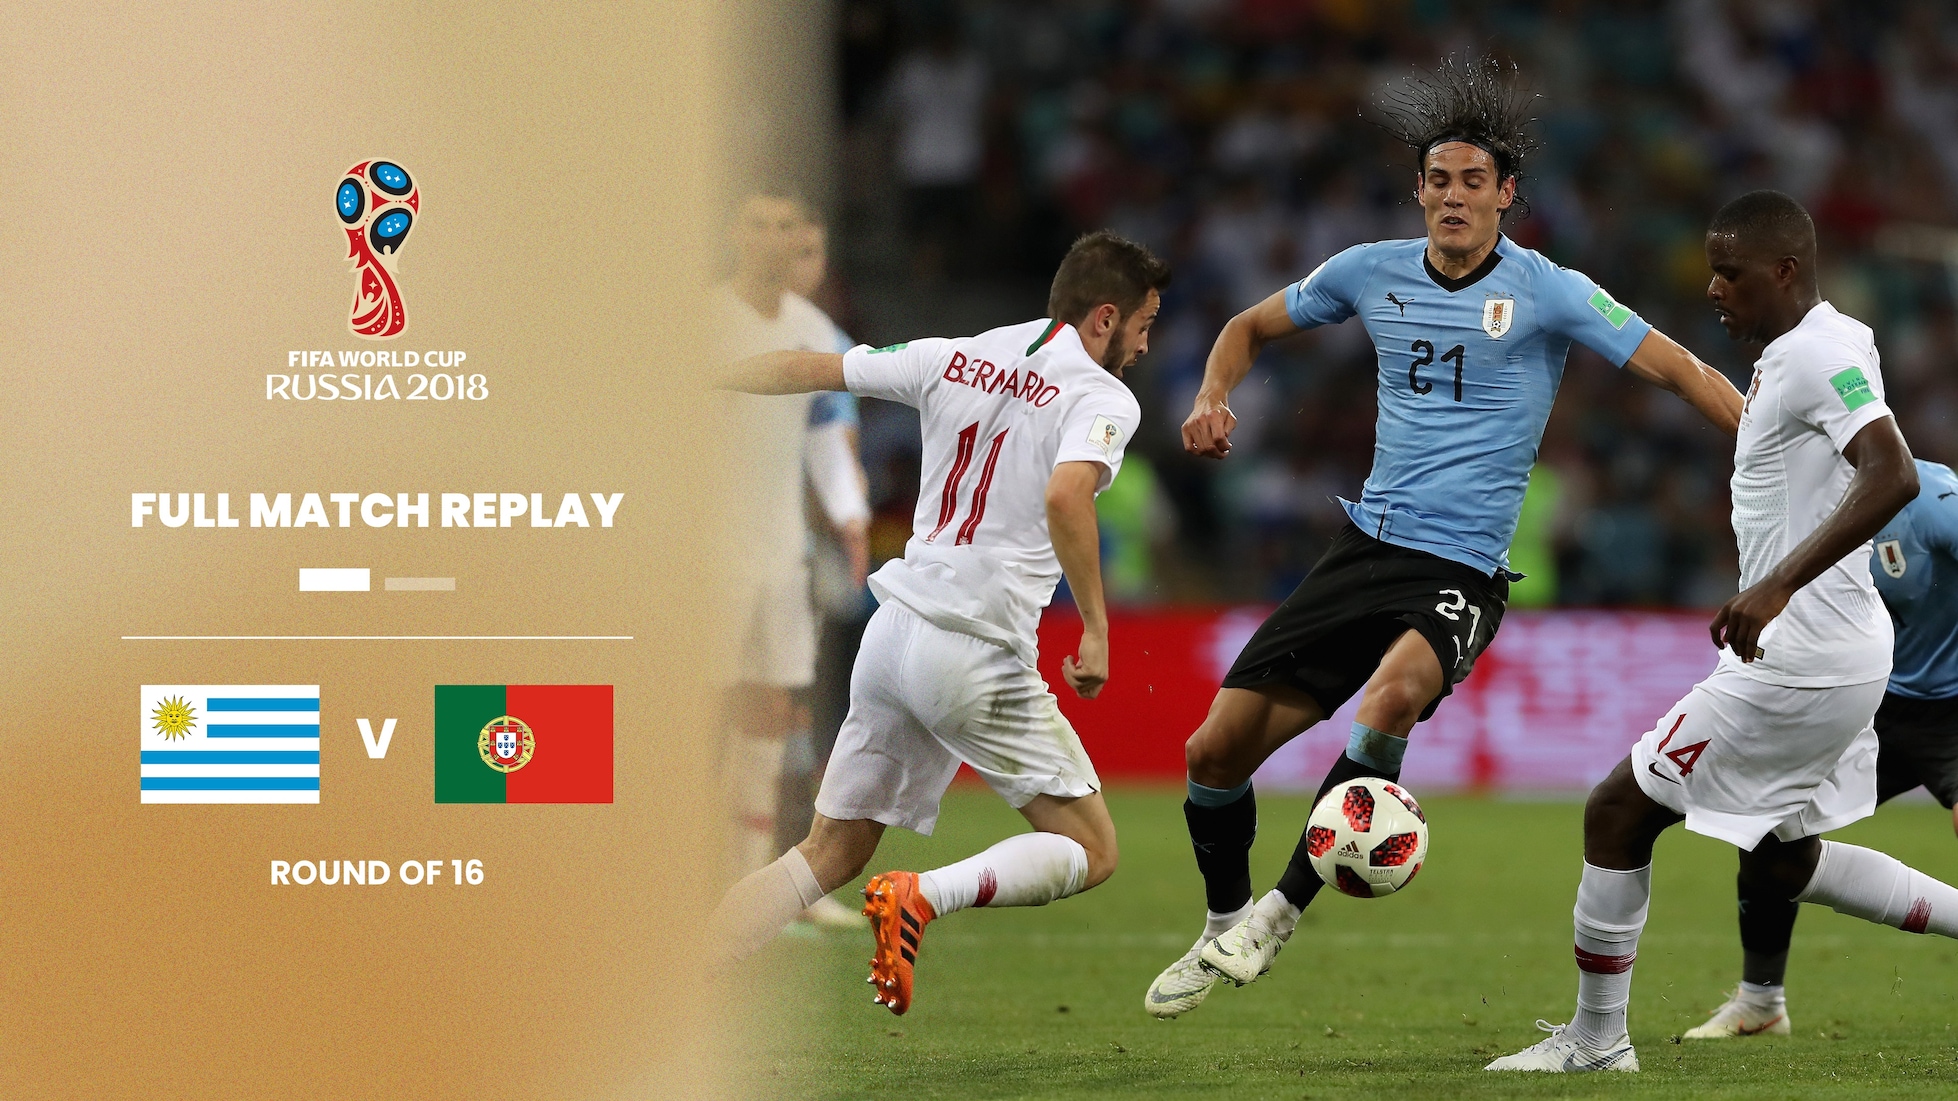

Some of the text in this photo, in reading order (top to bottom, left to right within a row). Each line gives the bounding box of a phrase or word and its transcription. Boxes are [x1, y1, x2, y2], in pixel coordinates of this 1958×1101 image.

[1408, 338, 1465, 402] 21
[926, 420, 1011, 547] 11
[1435, 588, 1482, 649] 21
[1657, 713, 1712, 778] 14
[1337, 850, 1364, 860] adidas
